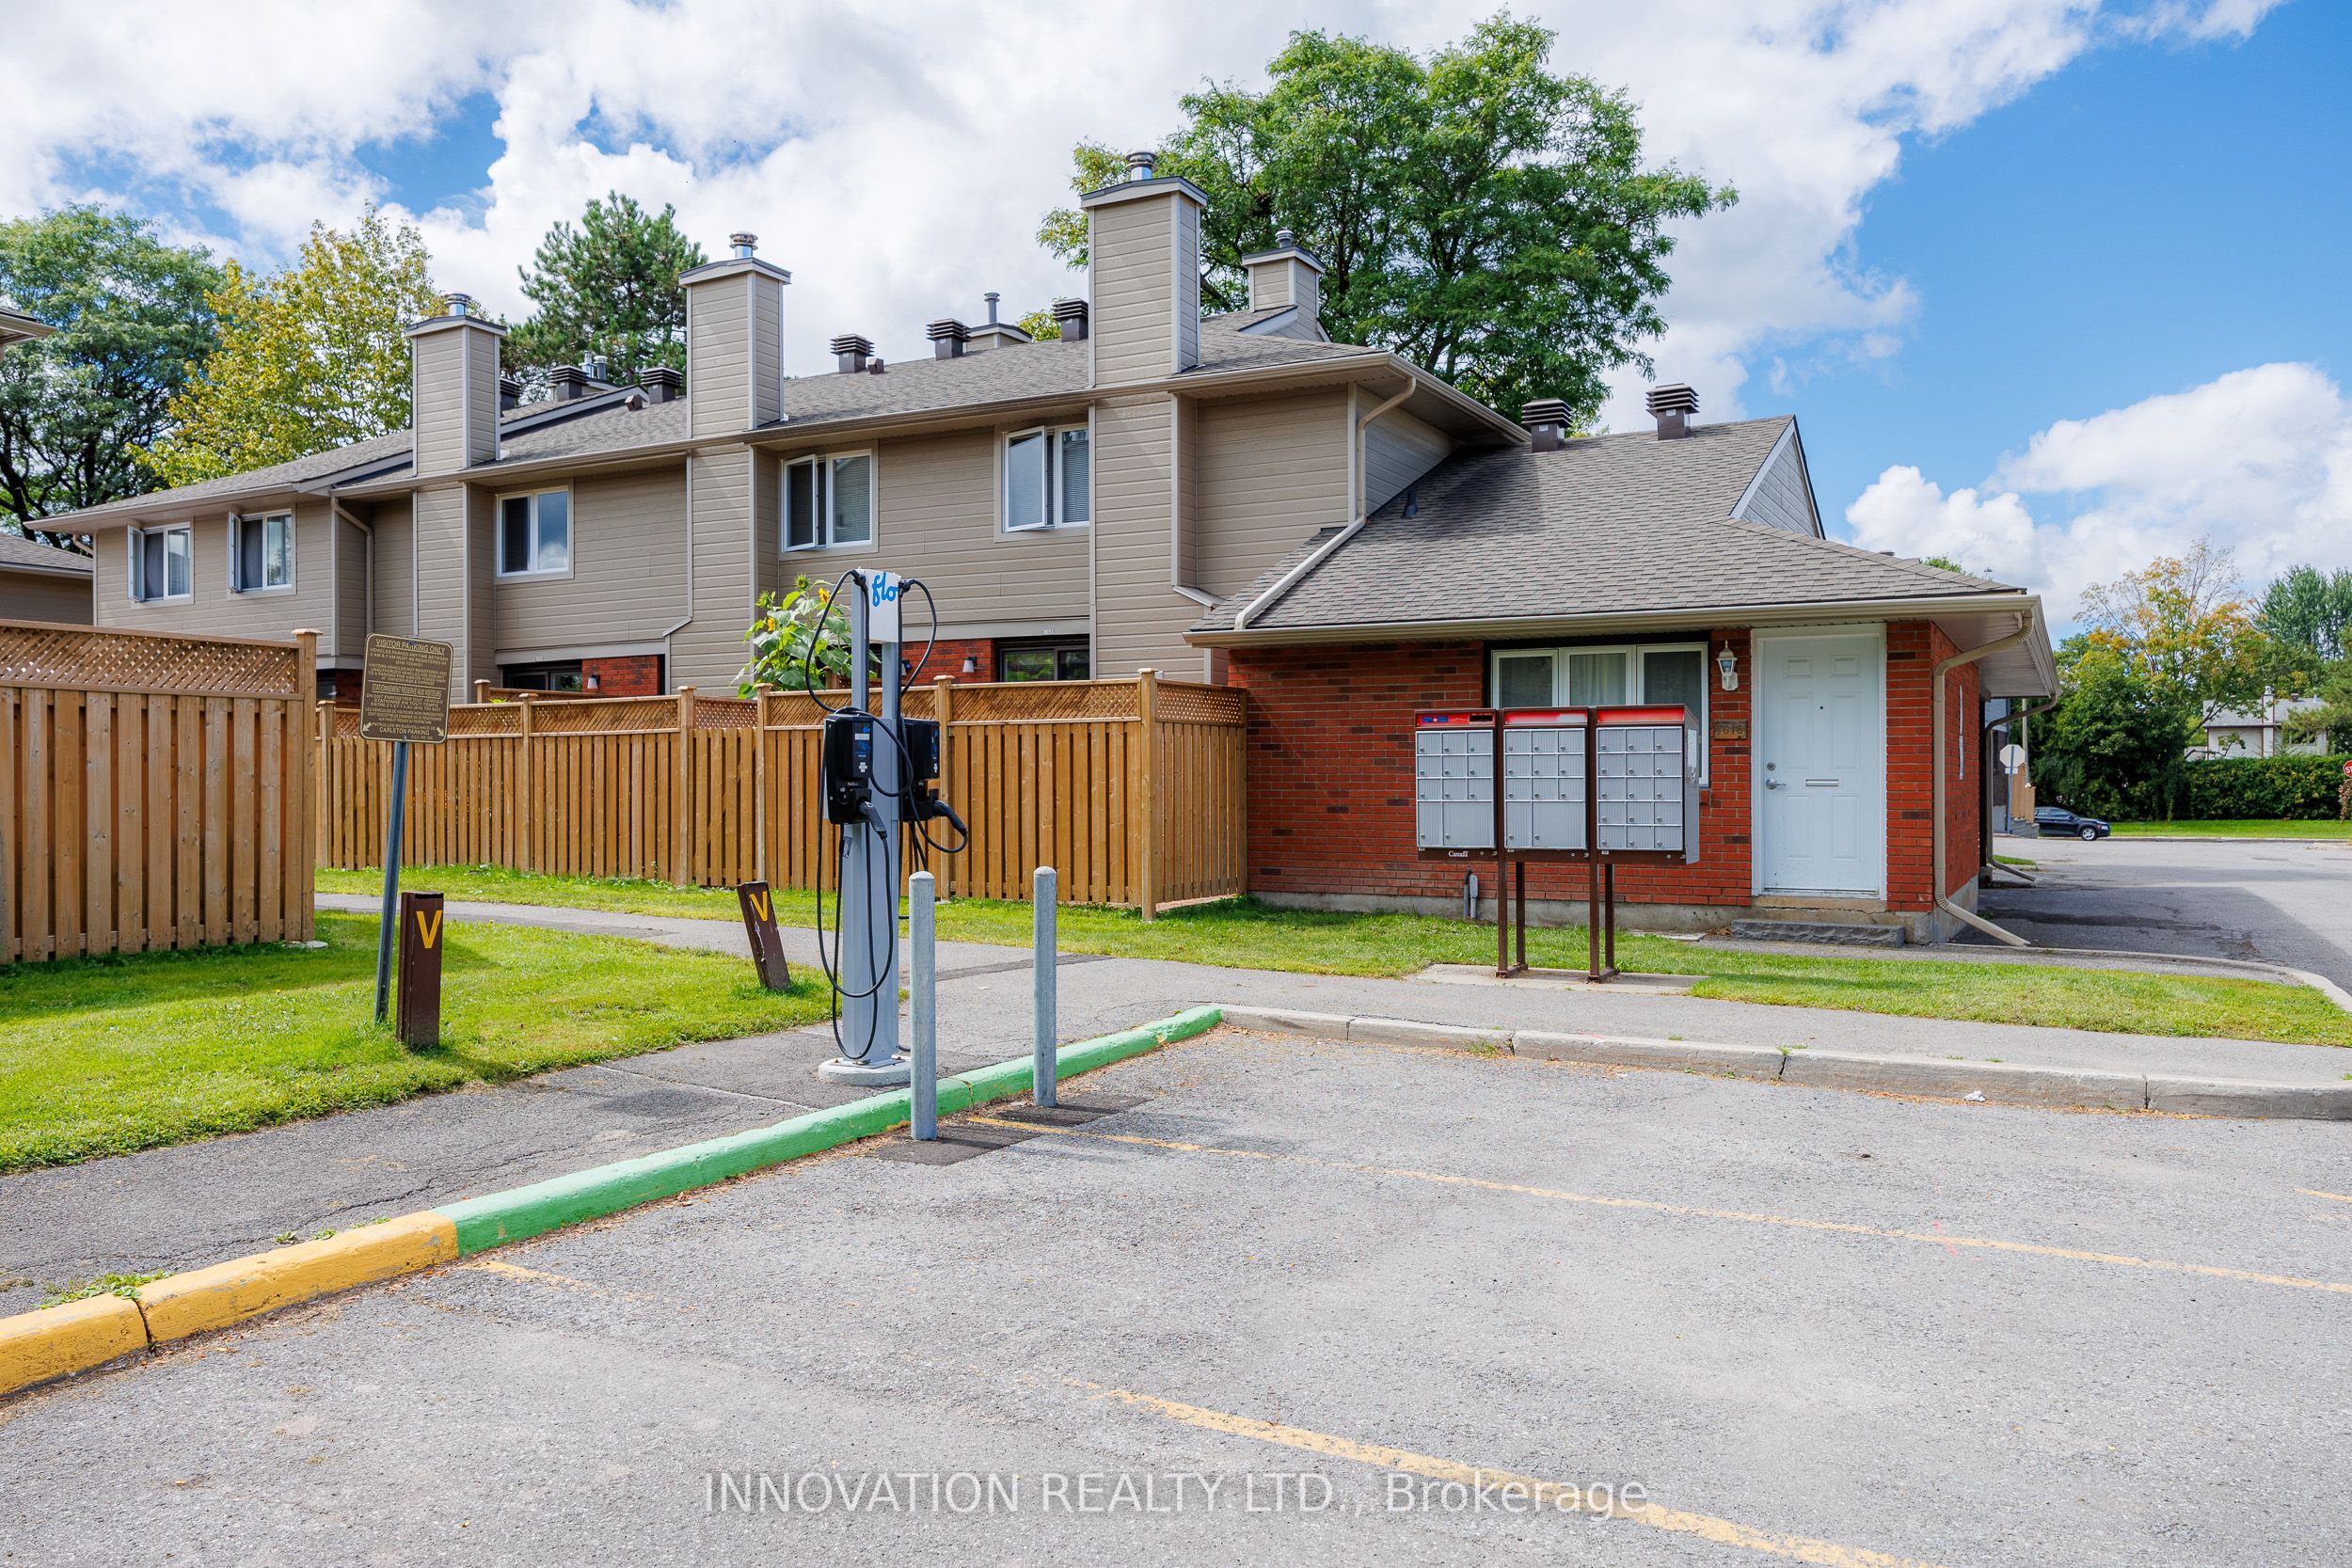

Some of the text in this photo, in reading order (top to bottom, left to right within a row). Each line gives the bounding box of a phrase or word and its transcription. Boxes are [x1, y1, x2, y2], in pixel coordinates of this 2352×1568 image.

[872, 571, 898, 607] flo
[375, 639, 401, 648] VISITOR
[402, 641, 428, 651] PARKING
[749, 890, 768, 922] V
[416, 910, 443, 949] V
